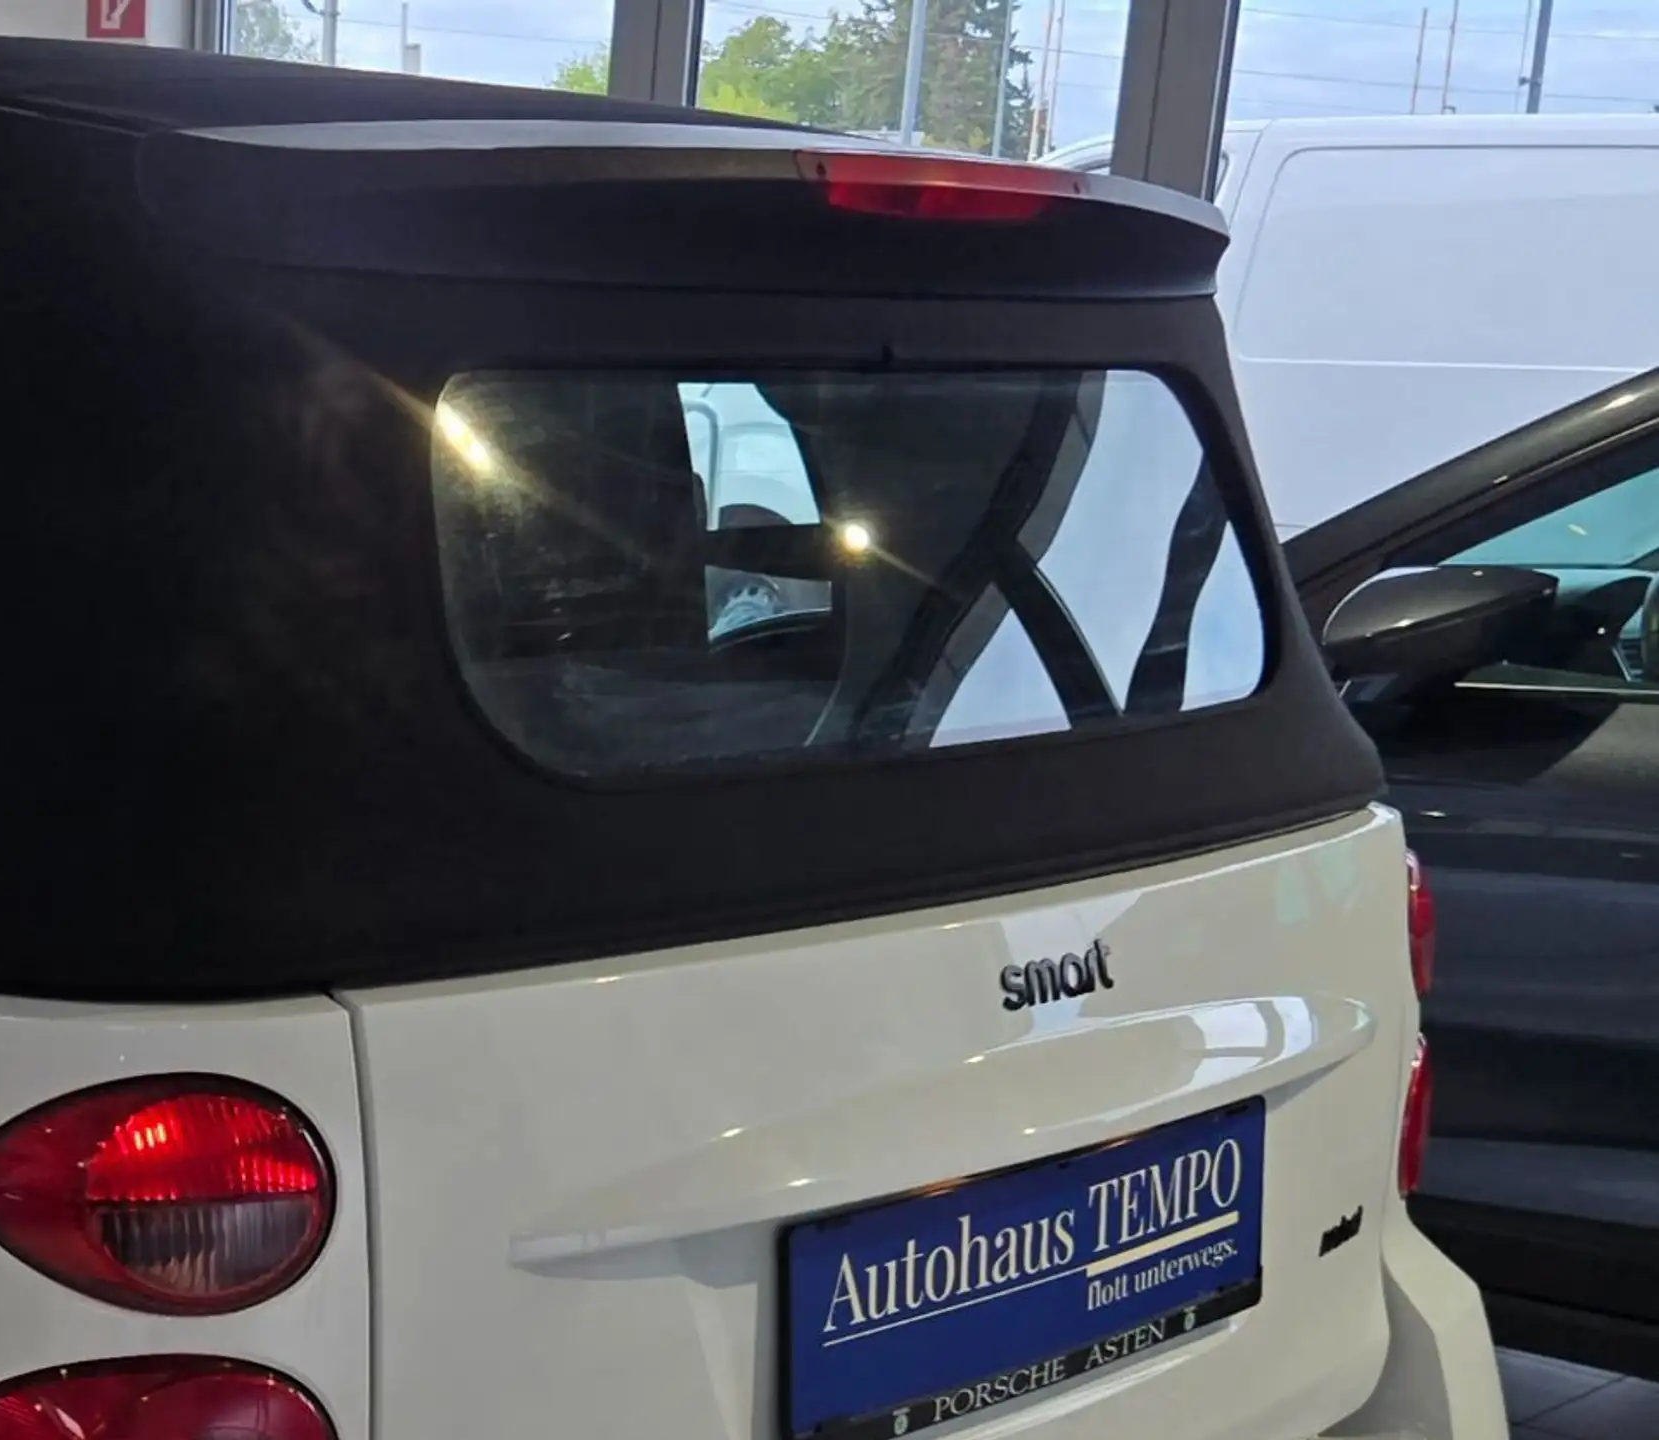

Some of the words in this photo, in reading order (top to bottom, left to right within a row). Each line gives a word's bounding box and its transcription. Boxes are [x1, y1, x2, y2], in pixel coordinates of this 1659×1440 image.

[1000, 938, 1114, 1011] smart
[823, 1209, 1075, 1332] Autohaus
[1088, 1138, 1241, 1252] TEMPO
[1086, 1273, 1129, 1311] flott
[1134, 1239, 1238, 1293] unterwegs.
[932, 1356, 1067, 1423] PORSCHE
[1085, 1317, 1167, 1370] ASTEN
